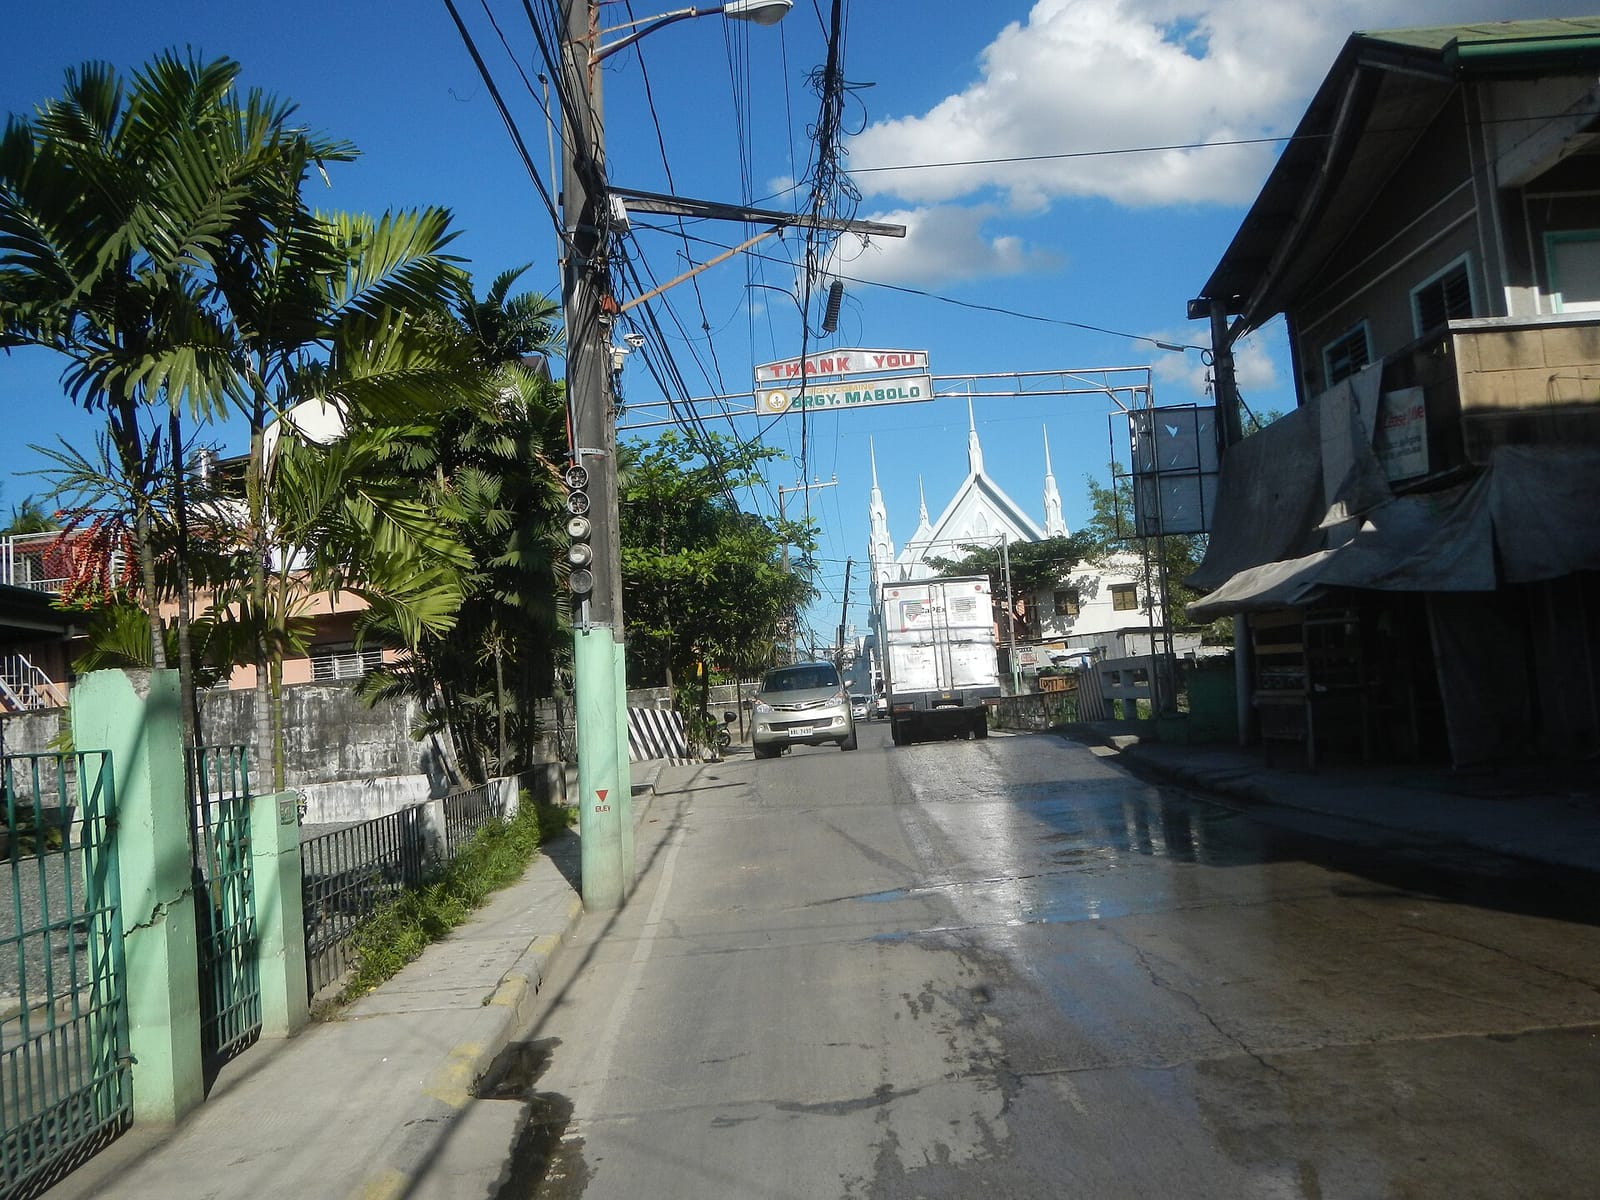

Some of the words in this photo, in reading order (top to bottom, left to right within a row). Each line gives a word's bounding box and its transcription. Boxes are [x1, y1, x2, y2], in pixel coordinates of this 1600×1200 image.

[770, 357, 850, 378] THANK
[873, 353, 915, 368] YOU
[792, 393, 841, 408] BRGY.
[845, 386, 920, 404] MABOLO
[833, 383, 875, 393] COMING
